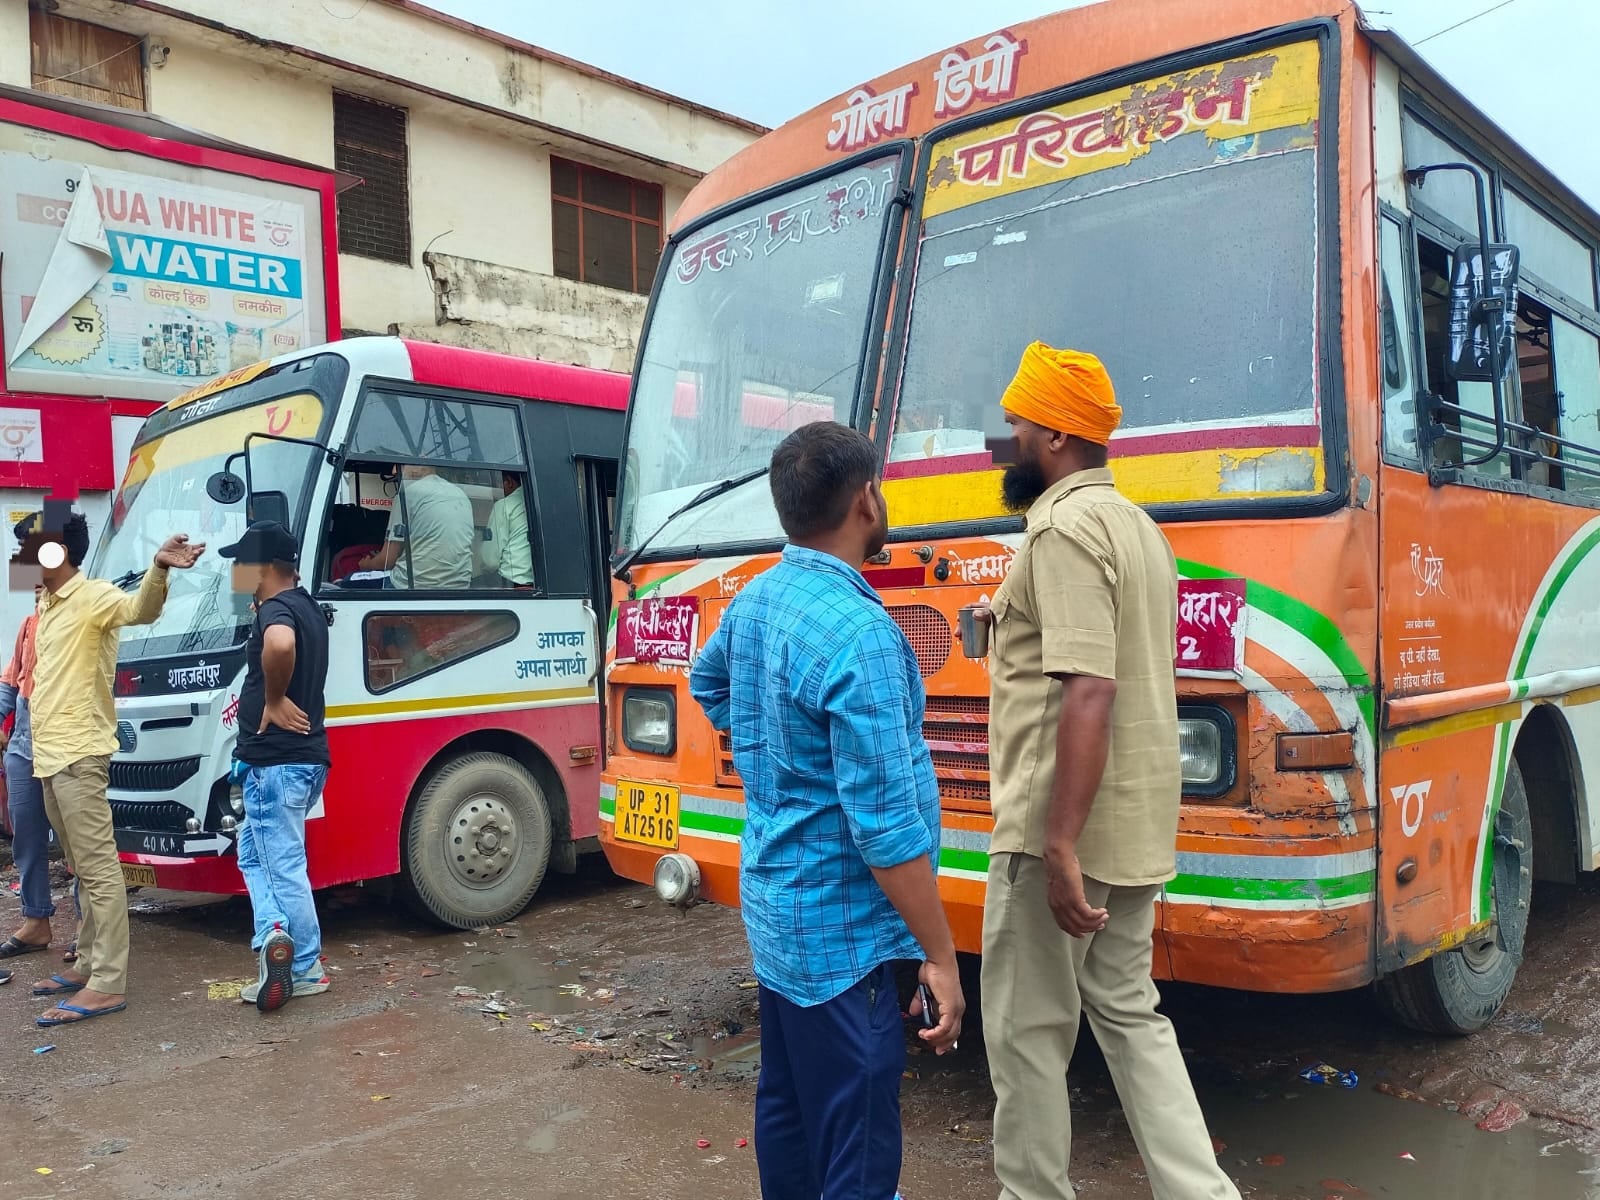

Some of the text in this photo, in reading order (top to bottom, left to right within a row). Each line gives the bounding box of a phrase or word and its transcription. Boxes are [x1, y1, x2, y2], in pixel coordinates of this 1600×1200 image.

[933, 33, 1026, 117] डिपो
[158, 196, 256, 243] WHITE
[115, 235, 290, 293] WATER
[149, 285, 181, 303] कोल्ड
[238, 298, 282, 315] नमकीन
[537, 631, 586, 649] आपका
[1180, 636, 1202, 660] 2
[168, 659, 221, 690] शाहजहाँपुर
[514, 652, 588, 680] अपना साथी
[629, 788, 645, 811] UP
[654, 791, 670, 815] 31
[624, 812, 673, 841] AT2516
[143, 836, 157, 852] 40
